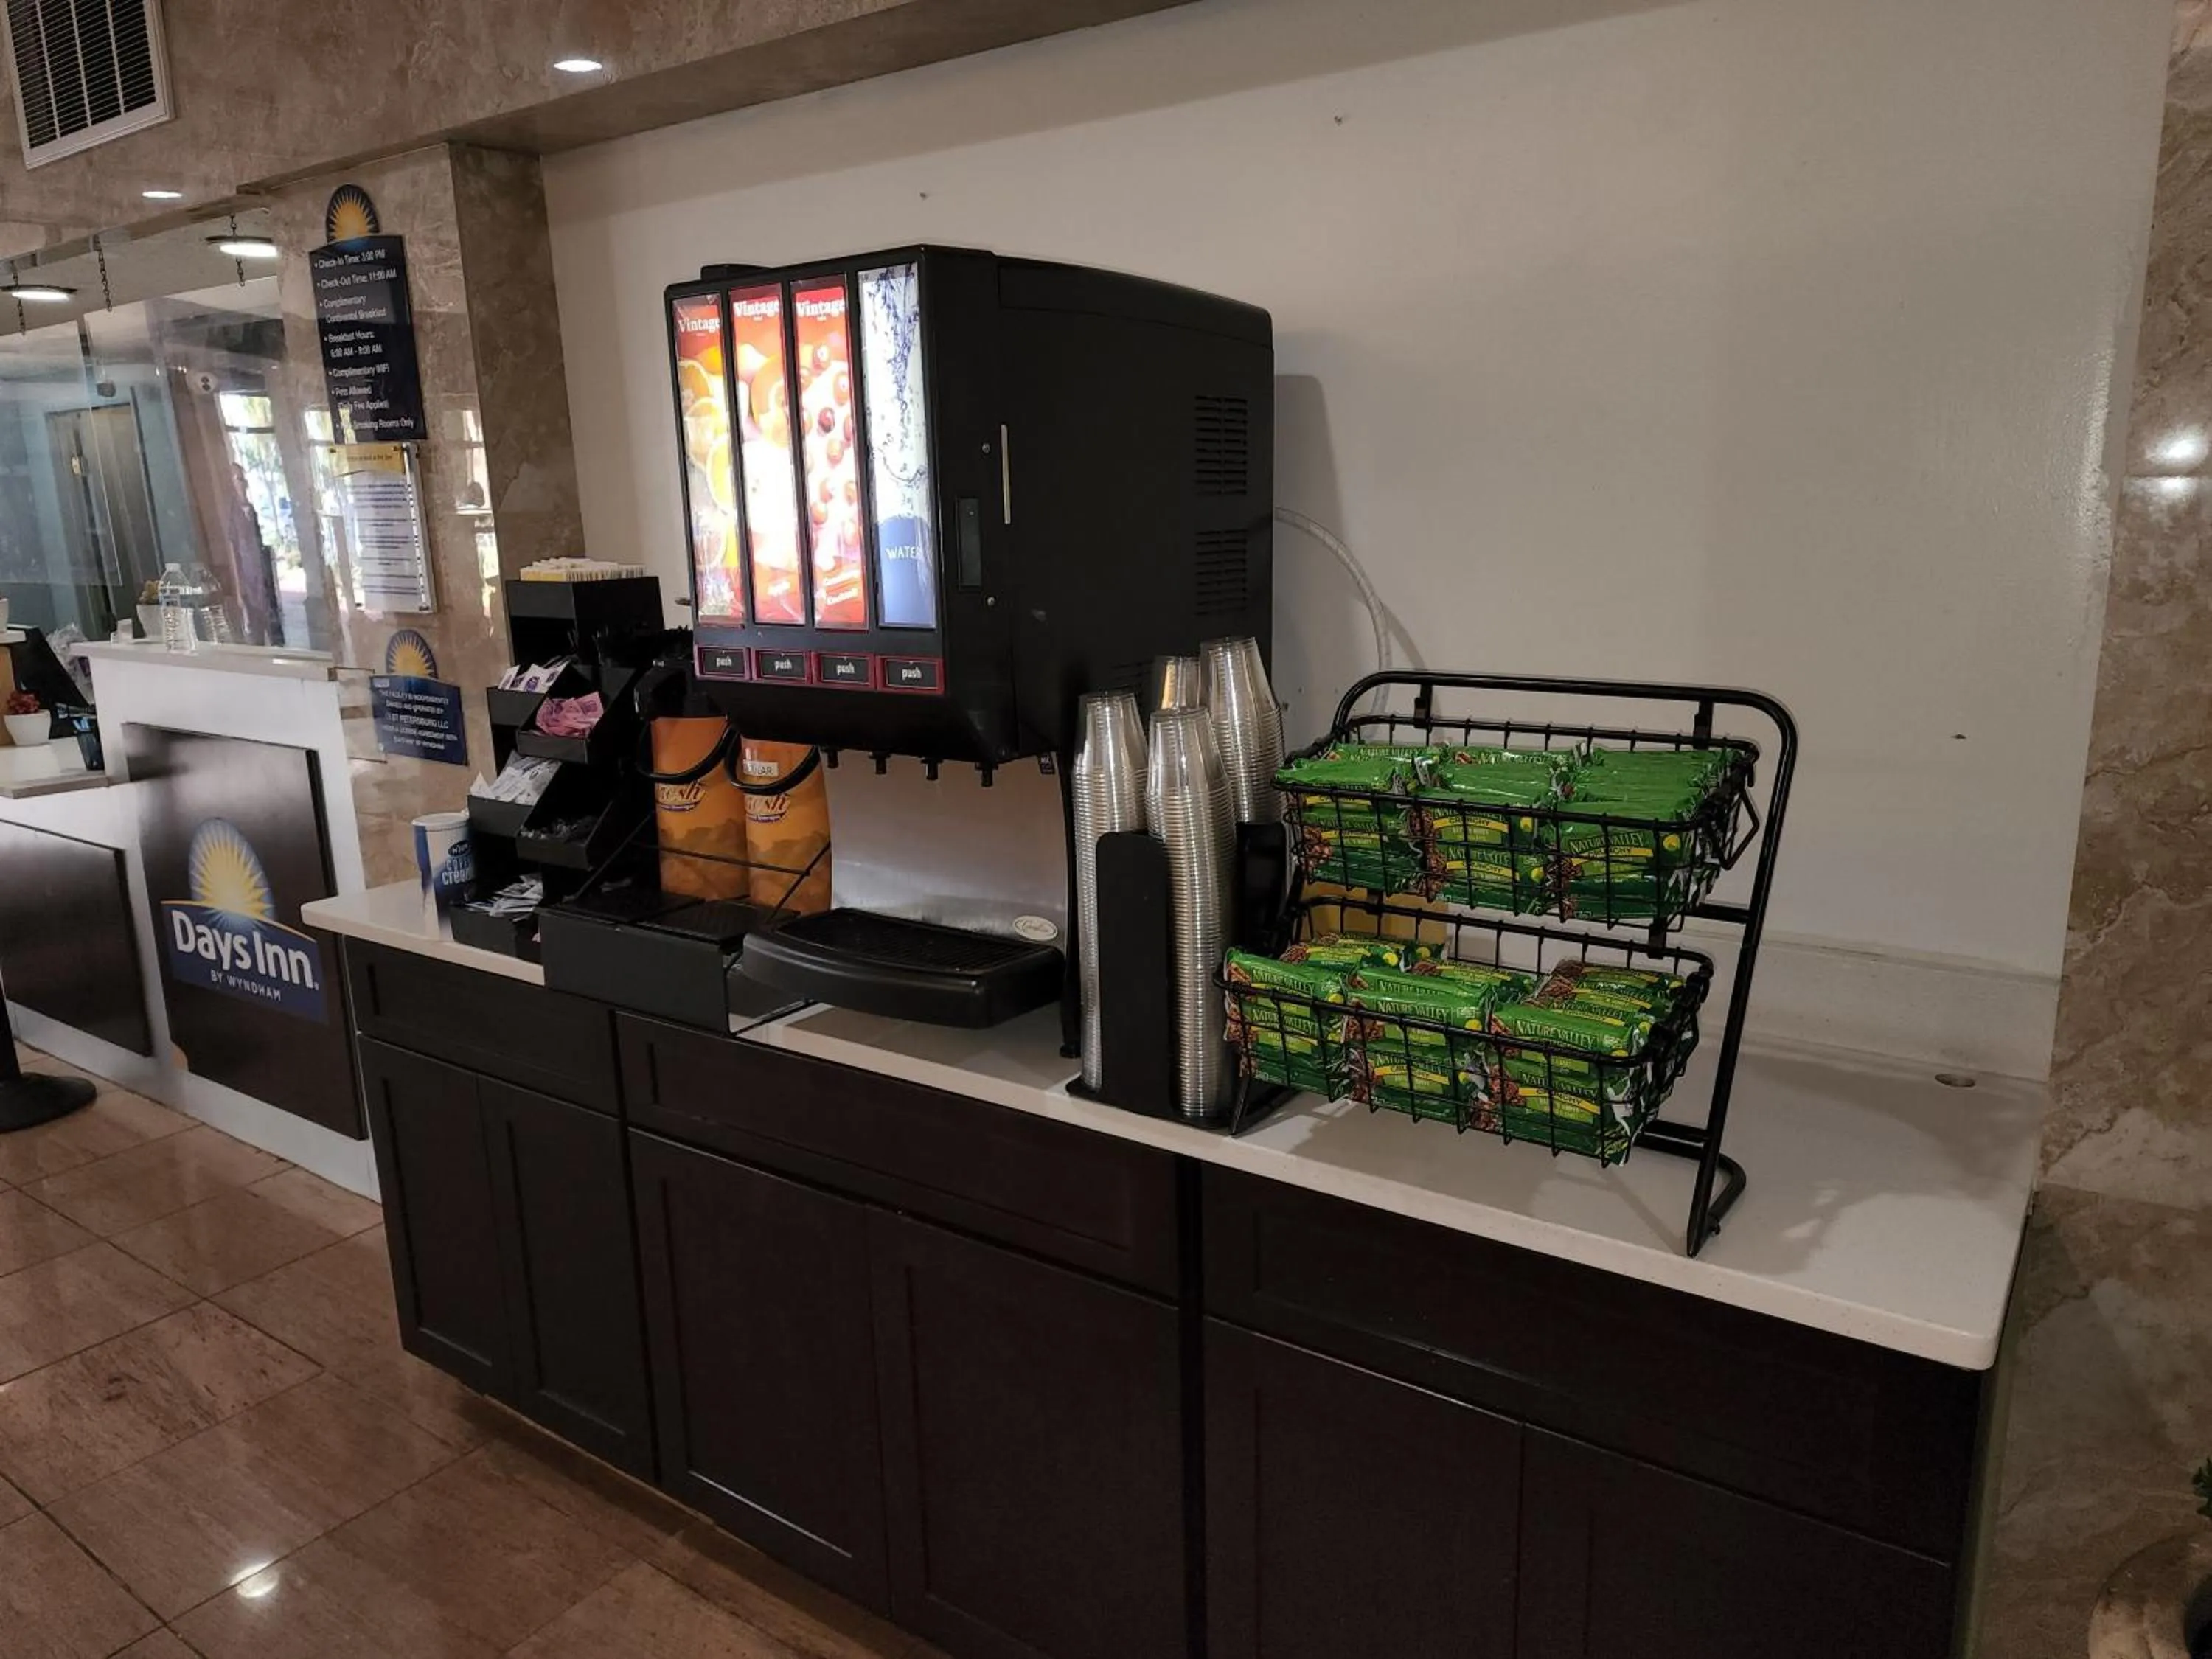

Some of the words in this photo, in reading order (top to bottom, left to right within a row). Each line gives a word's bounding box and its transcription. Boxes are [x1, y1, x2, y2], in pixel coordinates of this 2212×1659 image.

[386, 268, 397, 279] AM
[733, 299, 779, 317] Vintage
[796, 298, 845, 318] Vintage
[678, 317, 720, 333] Vintage
[717, 656, 732, 667] push
[775, 659, 792, 672] push
[837, 663, 855, 675] push
[902, 667, 922, 679] push
[1569, 835, 1607, 854] NATUR
[172, 910, 251, 970] Days
[252, 931, 314, 989] Inn
[210, 970, 222, 983] BY
[227, 975, 282, 1002] WYNDHAM
[1377, 1001, 1415, 1015] NATURE
[1415, 1005, 1450, 1023] VALLEY
[1517, 1020, 1558, 1037] NATURE
[1559, 1030, 1596, 1051] VALLEY
